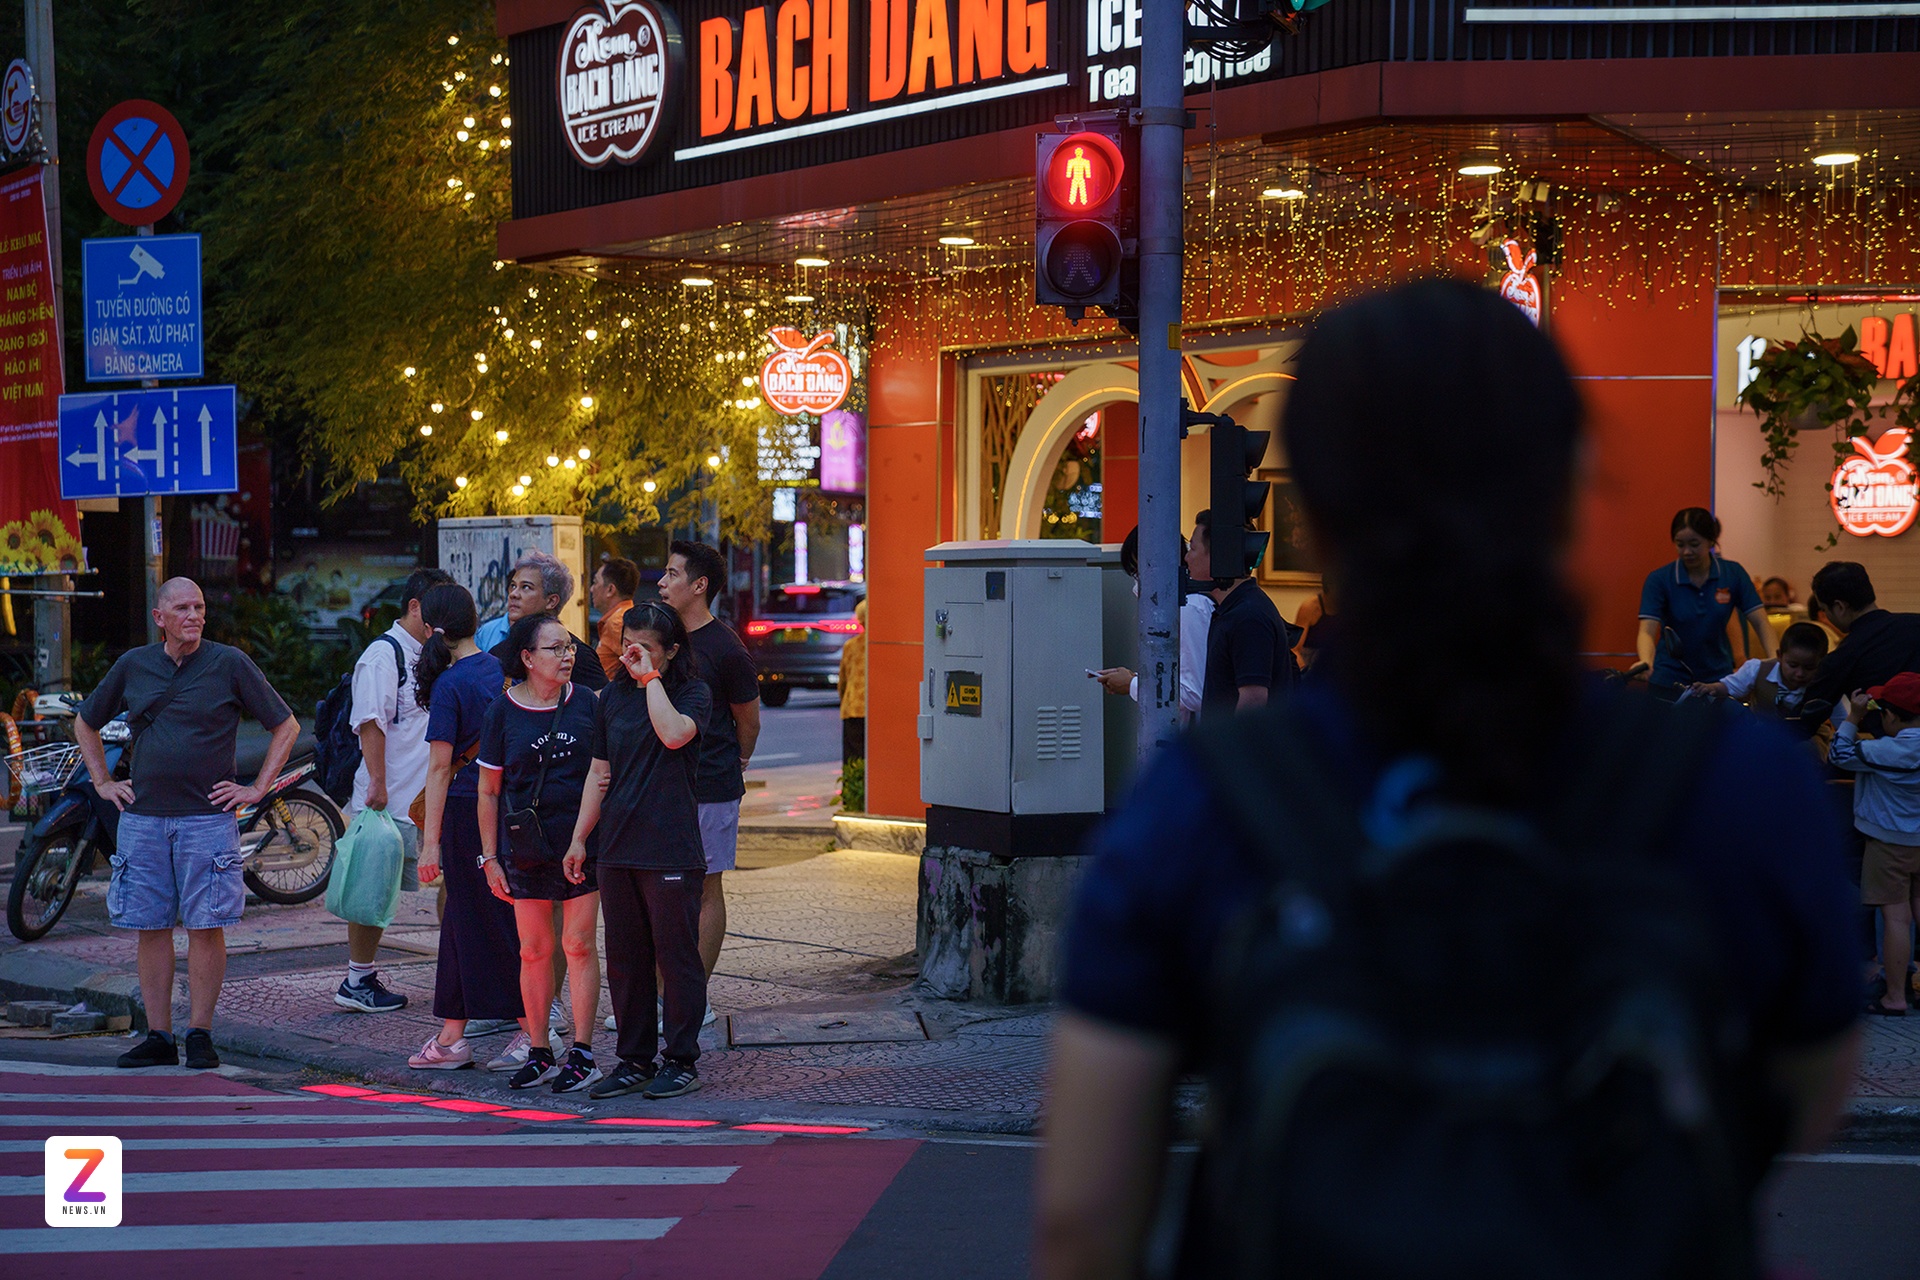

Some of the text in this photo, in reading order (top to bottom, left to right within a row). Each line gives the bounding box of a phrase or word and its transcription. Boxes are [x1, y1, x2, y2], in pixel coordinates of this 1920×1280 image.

[1087, 64, 1136, 103] Tea
[577, 112, 646, 143] ICE CREAM
[96, 290, 191, 319] TUYẾN ĐƯỜNG CÓ
[91, 322, 119, 347] GIÁM
[148, 318, 164, 344] XỬ
[165, 323, 195, 348] PHẠT
[4, 358, 26, 376] HÀO
[105, 347, 184, 375] BẰNG CAMERA
[778, 396, 832, 404] ICE CREAM
[1848, 512, 1901, 522] ICE CREAM
